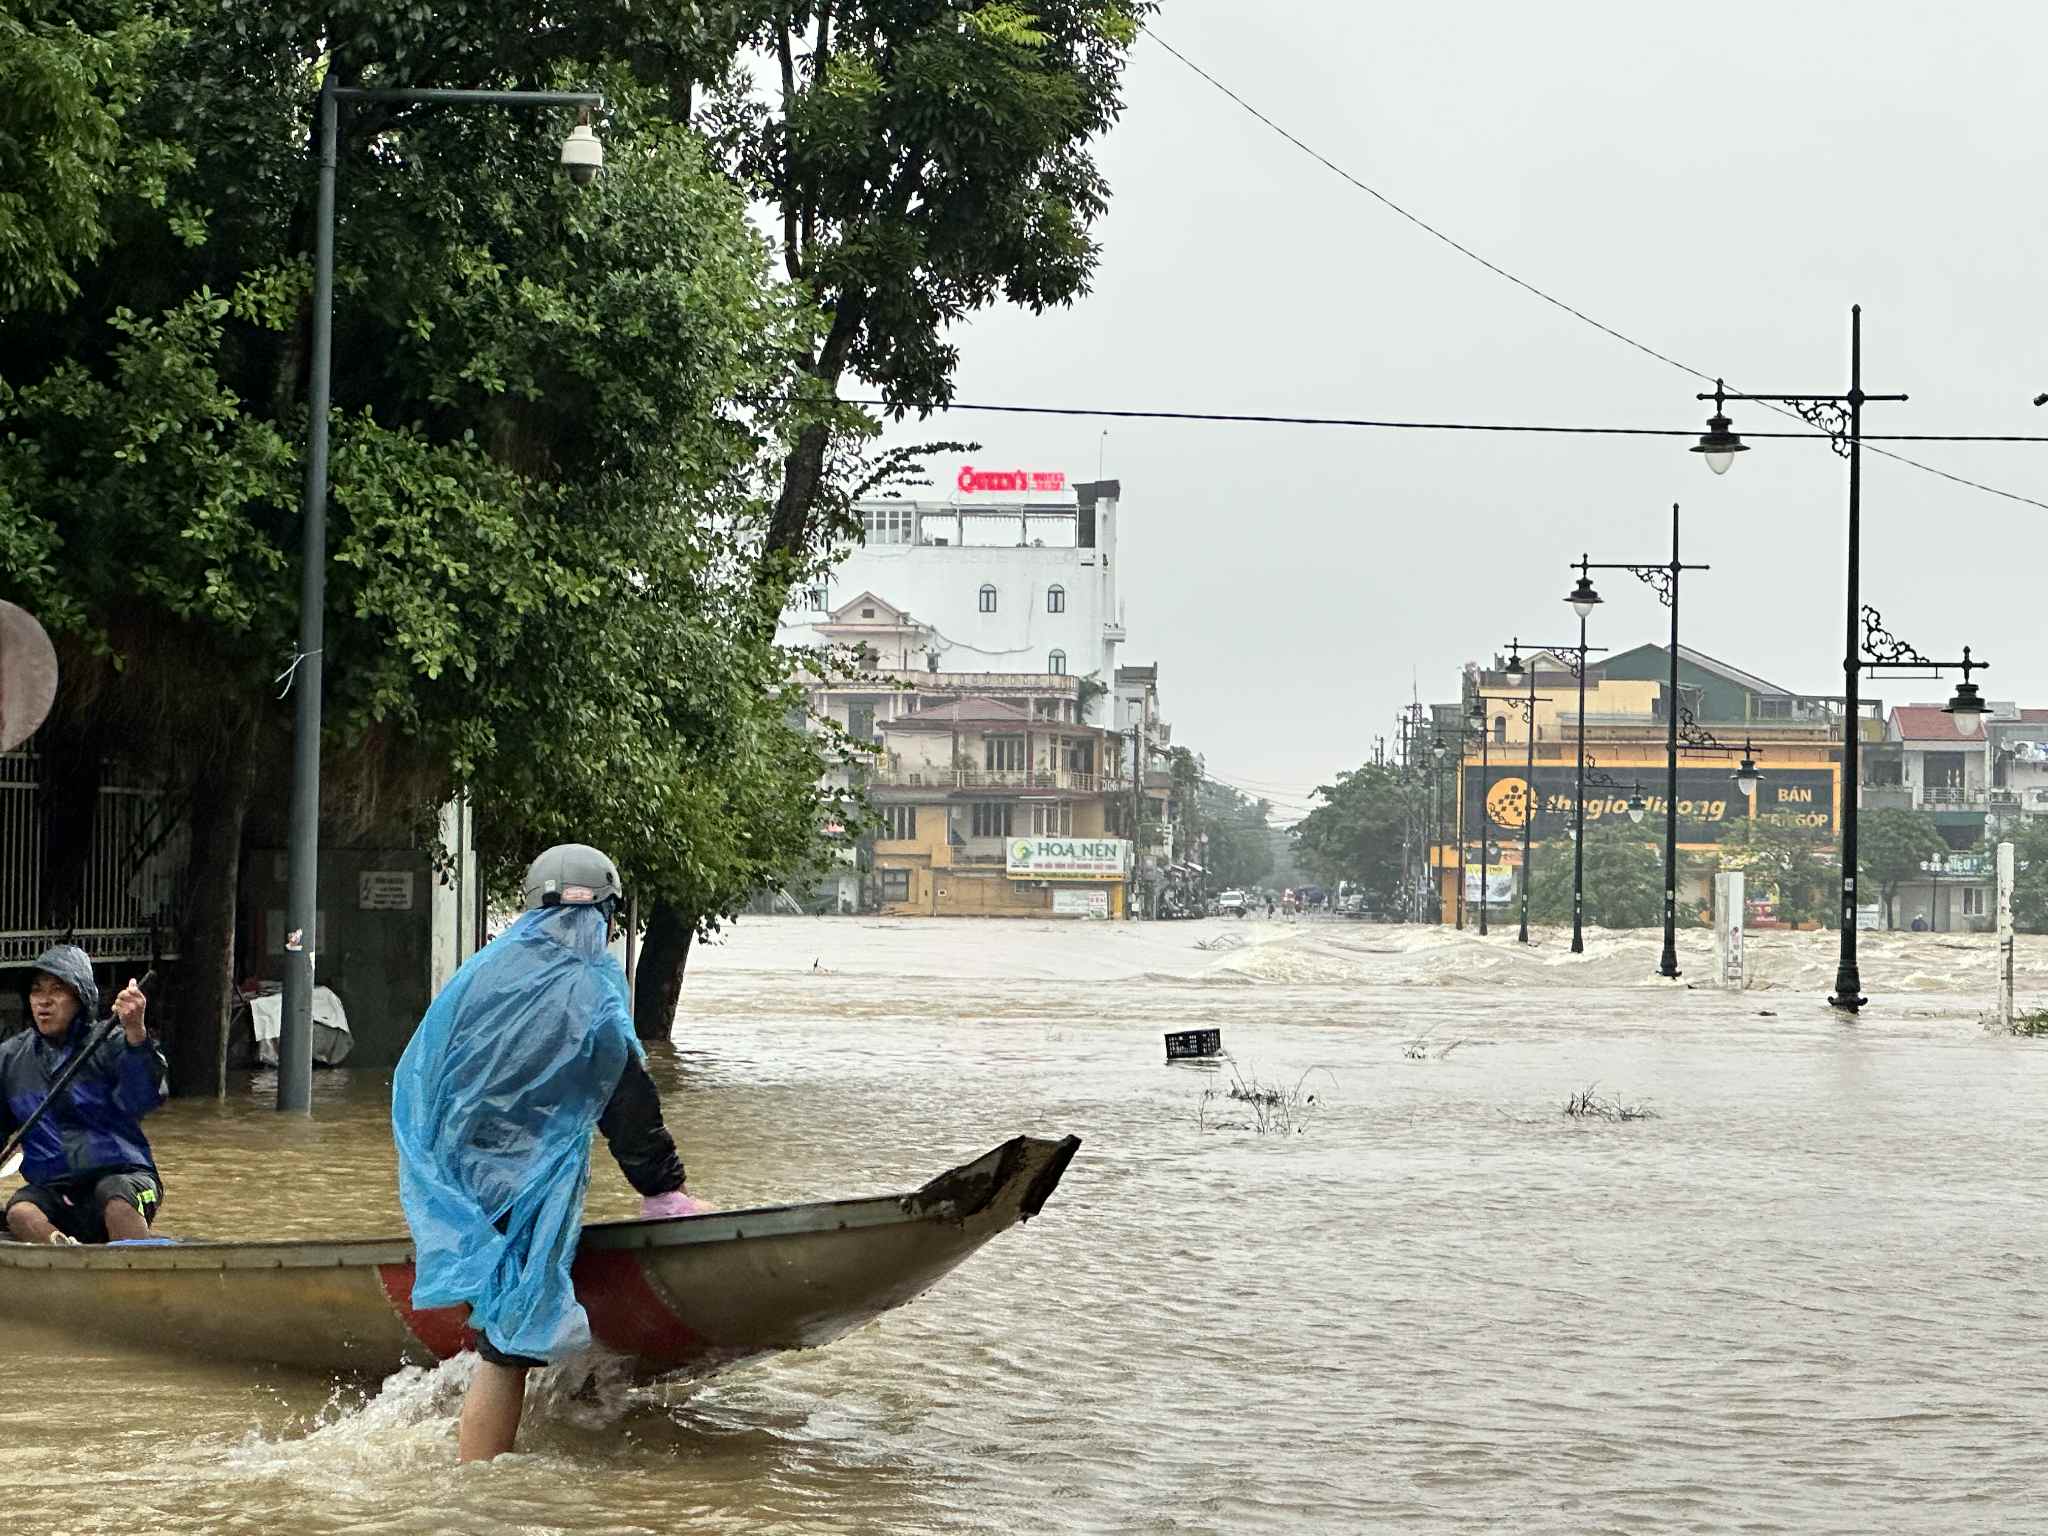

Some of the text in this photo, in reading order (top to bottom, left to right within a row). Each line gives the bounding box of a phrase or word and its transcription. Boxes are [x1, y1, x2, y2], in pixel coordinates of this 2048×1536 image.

[1777, 785, 1812, 802] BÁN
[1795, 810, 1828, 828] GÓP
[1038, 842, 1074, 857] HOA
